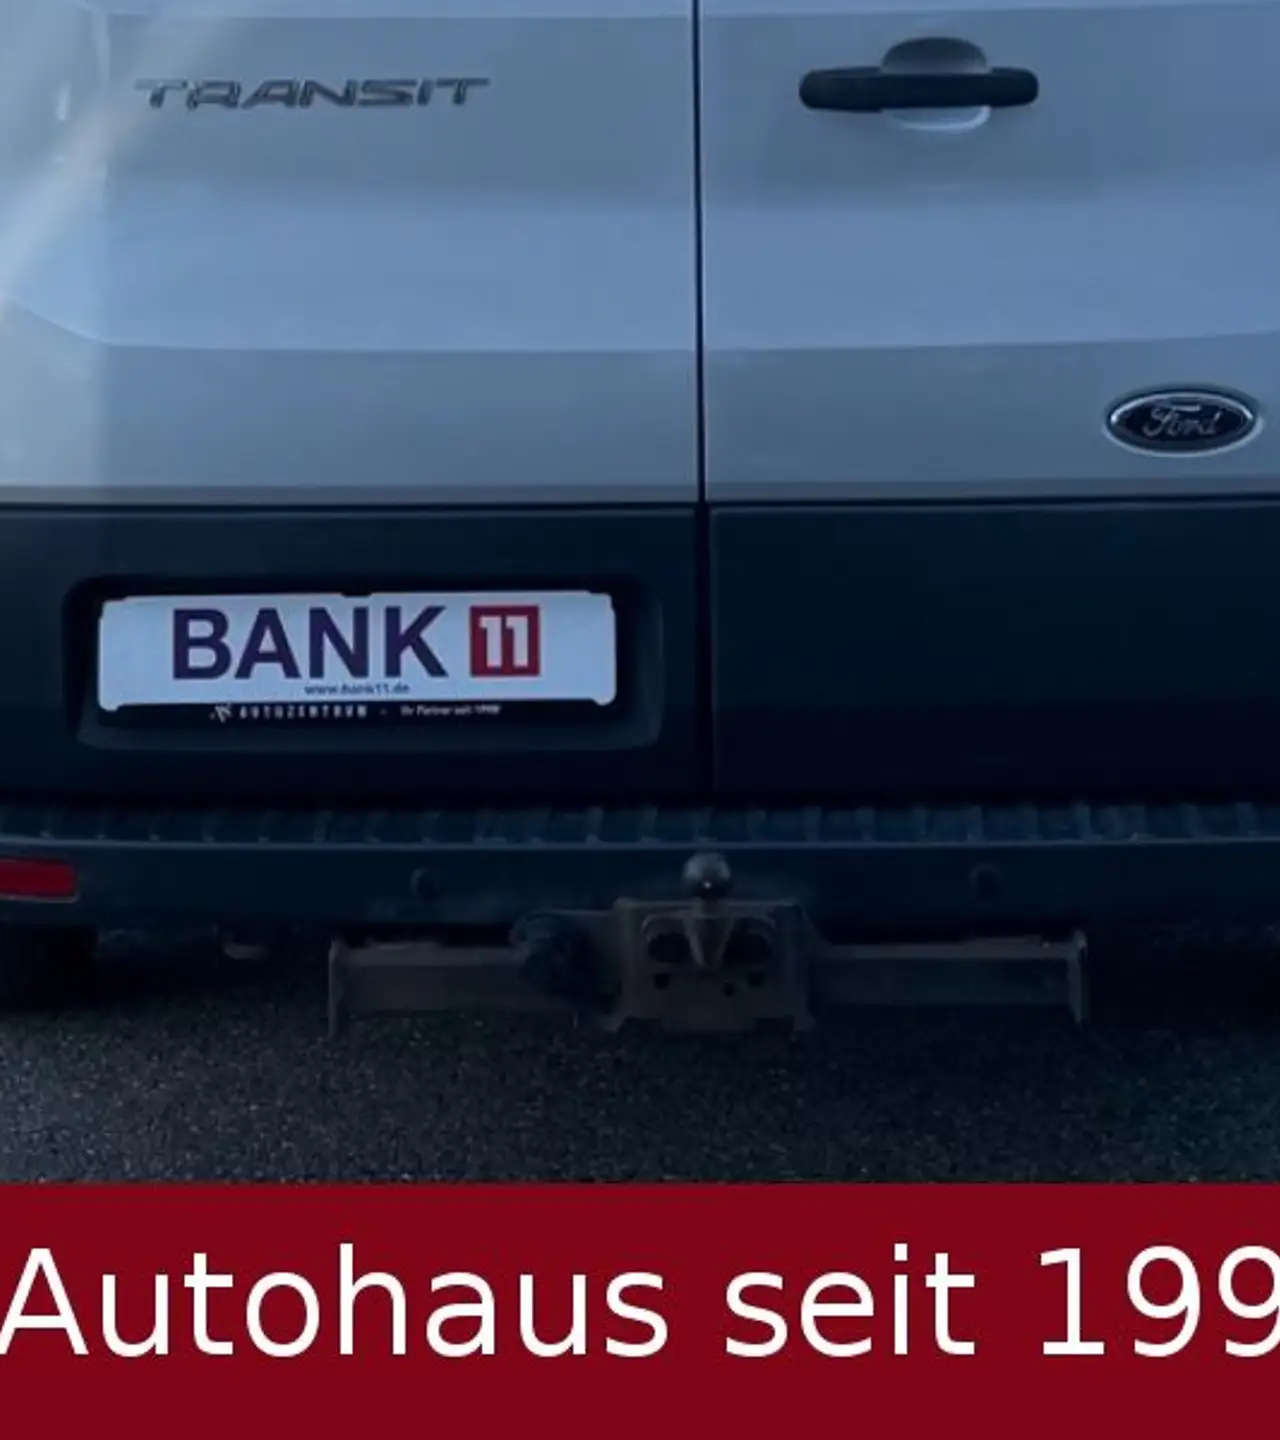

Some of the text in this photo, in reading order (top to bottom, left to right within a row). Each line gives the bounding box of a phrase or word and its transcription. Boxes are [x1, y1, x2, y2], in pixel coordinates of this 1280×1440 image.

[135, 77, 490, 110] TRANSIT
[172, 603, 535, 680] BANK 11
